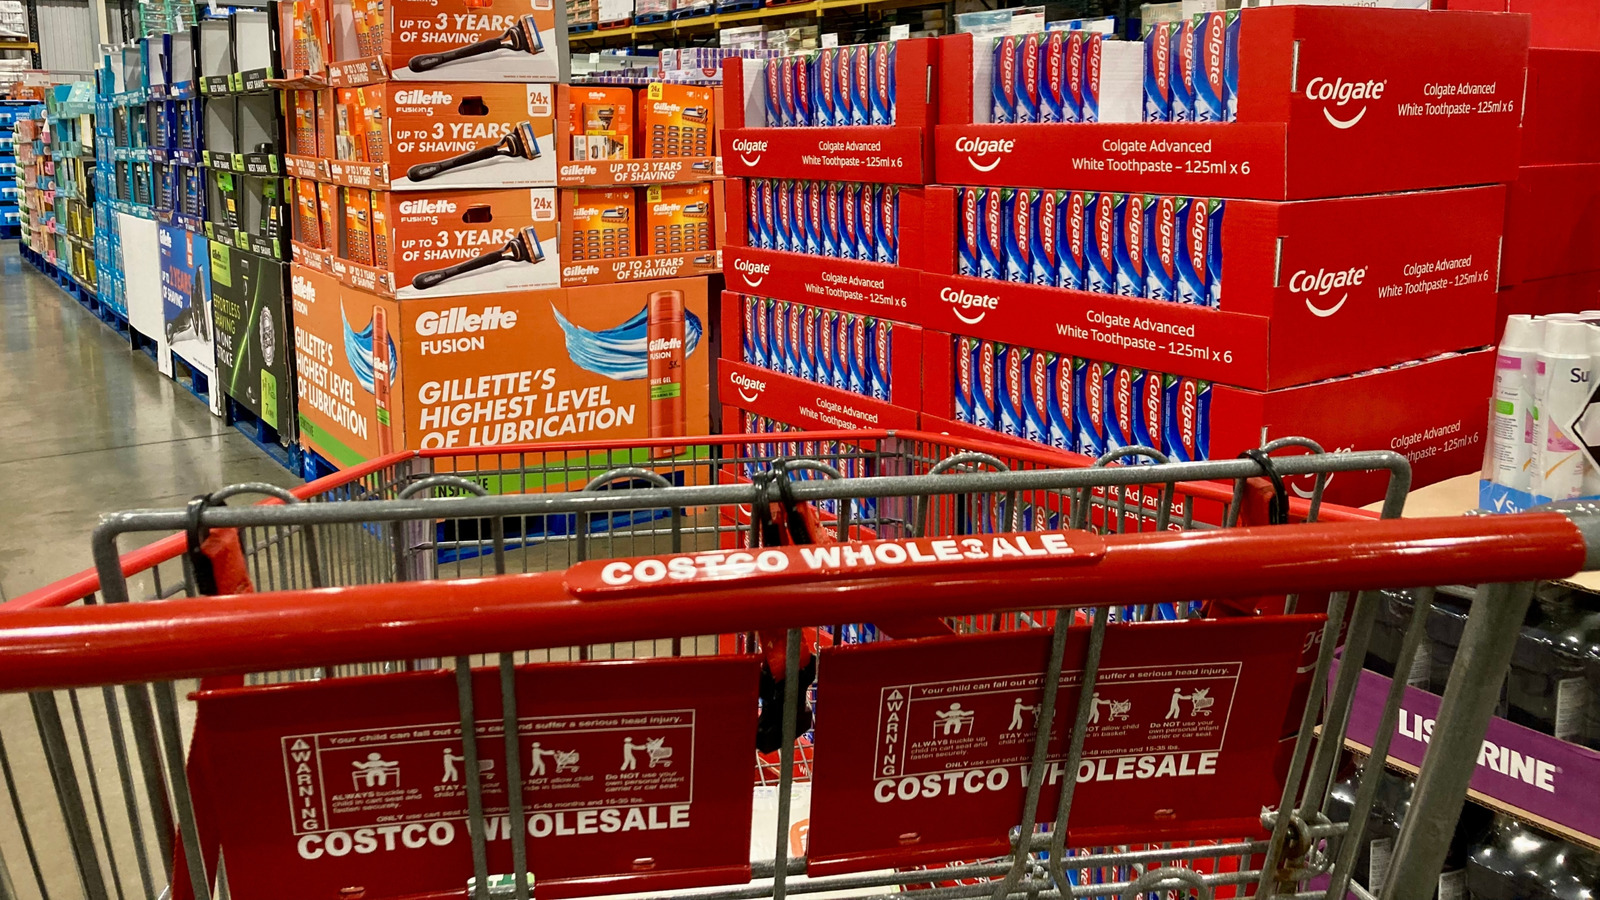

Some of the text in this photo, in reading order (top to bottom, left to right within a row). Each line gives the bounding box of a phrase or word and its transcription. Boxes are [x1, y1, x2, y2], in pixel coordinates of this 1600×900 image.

[400, 13, 514, 32] UP TO 3 YEARS
[400, 32, 418, 43] OF
[1210, 14, 1224, 86] Colgate
[824, 50, 832, 100] Colgate
[1004, 38, 1014, 94] Colgate
[1050, 34, 1060, 92] Colgate
[395, 90, 452, 105] Gillette
[529, 92, 548, 106] 24x
[1305, 77, 1386, 106] Colgate
[1424, 82, 1496, 97] Colgate Advanced
[653, 102, 680, 112] Gillette
[1397, 100, 1514, 118] White Toothpaste 125ml 6
[396, 123, 510, 140] UP TO 3 YEARS
[397, 141, 416, 153] OF
[732, 138, 767, 154] Colgate
[818, 140, 881, 153] Colgate Advanced
[956, 136, 1014, 156] Colgate
[1102, 139, 1212, 156] Colgate Advanced
[560, 165, 597, 176] Gillette
[802, 155, 903, 168] White Toothpaste 125ml 6
[1072, 158, 1250, 174] White Toothpaste 125ml 6
[400, 200, 456, 215] Gillette
[534, 197, 552, 210] 24x
[653, 204, 681, 212] Gillette
[885, 186, 893, 238] Colgate
[966, 189, 976, 246] Colgate
[1044, 192, 1056, 253] Colgate
[1100, 194, 1112, 260] Colgate
[402, 228, 514, 249] UP TO 3 YEARS
[1161, 198, 1174, 266] Colgate
[1194, 201, 1207, 270] Colgate
[402, 250, 422, 262] OF
[612, 257, 684, 272] UP TO 3 YEARS
[734, 258, 770, 275] Colgate
[1403, 254, 1472, 277] Colgate Advanced
[563, 266, 600, 276] Gillette
[616, 270, 630, 280] OF
[822, 272, 884, 290] Colgate Advanced
[1288, 266, 1366, 296] Colgate
[1378, 270, 1489, 298] White Toothpaste 125ml 6
[292, 275, 316, 302] Gillette
[804, 282, 907, 308] White Toothpaste 125ml 6
[940, 287, 998, 310] Colgate
[214, 293, 240, 320] EFFORTLESS
[415, 306, 518, 336] Gillette
[1086, 310, 1194, 337] Colgate Advanced
[221, 332, 232, 351] ONE
[420, 336, 484, 356] FUSION
[649, 338, 682, 352] Gillette
[1056, 323, 1232, 364] White Toothpaste 125ml 6
[217, 344, 233, 368] STROKE
[296, 353, 356, 407] HIGHEST LEVEL
[418, 368, 556, 404] GILLETTE'S
[730, 372, 765, 392] Colgate
[1034, 352, 1046, 411] Colgate
[298, 375, 309, 398] OF
[309, 383, 368, 440] LUBRICATION
[419, 386, 611, 430] HIGHEST LEVEL
[816, 398, 878, 424] Colgate Advanced
[1120, 368, 1131, 433] Colgate
[420, 405, 636, 449] OF LUBRICATION
[800, 406, 856, 430] White Toothpaste
[1183, 381, 1196, 448] Colgate
[1390, 420, 1461, 449] Colgate Advanced
[1444, 432, 1479, 452] 125ml 6
[601, 534, 1075, 586] COSTCO WHOLESALE
[921, 687, 944, 696] Your
[946, 684, 970, 692] child
[973, 682, 990, 690] can
[993, 680, 1007, 688] fall
[1028, 678, 1039, 686] of
[1100, 672, 1127, 680] suffer
[1138, 670, 1172, 678] serious
[1175, 668, 1198, 676] head
[1200, 668, 1230, 676] injury.
[329, 736, 356, 746] Your
[359, 732, 388, 742] child
[390, 731, 411, 740] can
[412, 728, 432, 738] fall
[432, 728, 452, 736] out
[535, 720, 566, 730] suffer
[578, 717, 618, 728] serious
[621, 716, 648, 726] head
[882, 700, 904, 776] WARNING
[912, 739, 948, 749] ALWAYS
[1398, 708, 1556, 793] LISRINE
[291, 751, 319, 830] WARNING
[874, 768, 1009, 803] COSTCO
[298, 821, 455, 860] COSTCO
